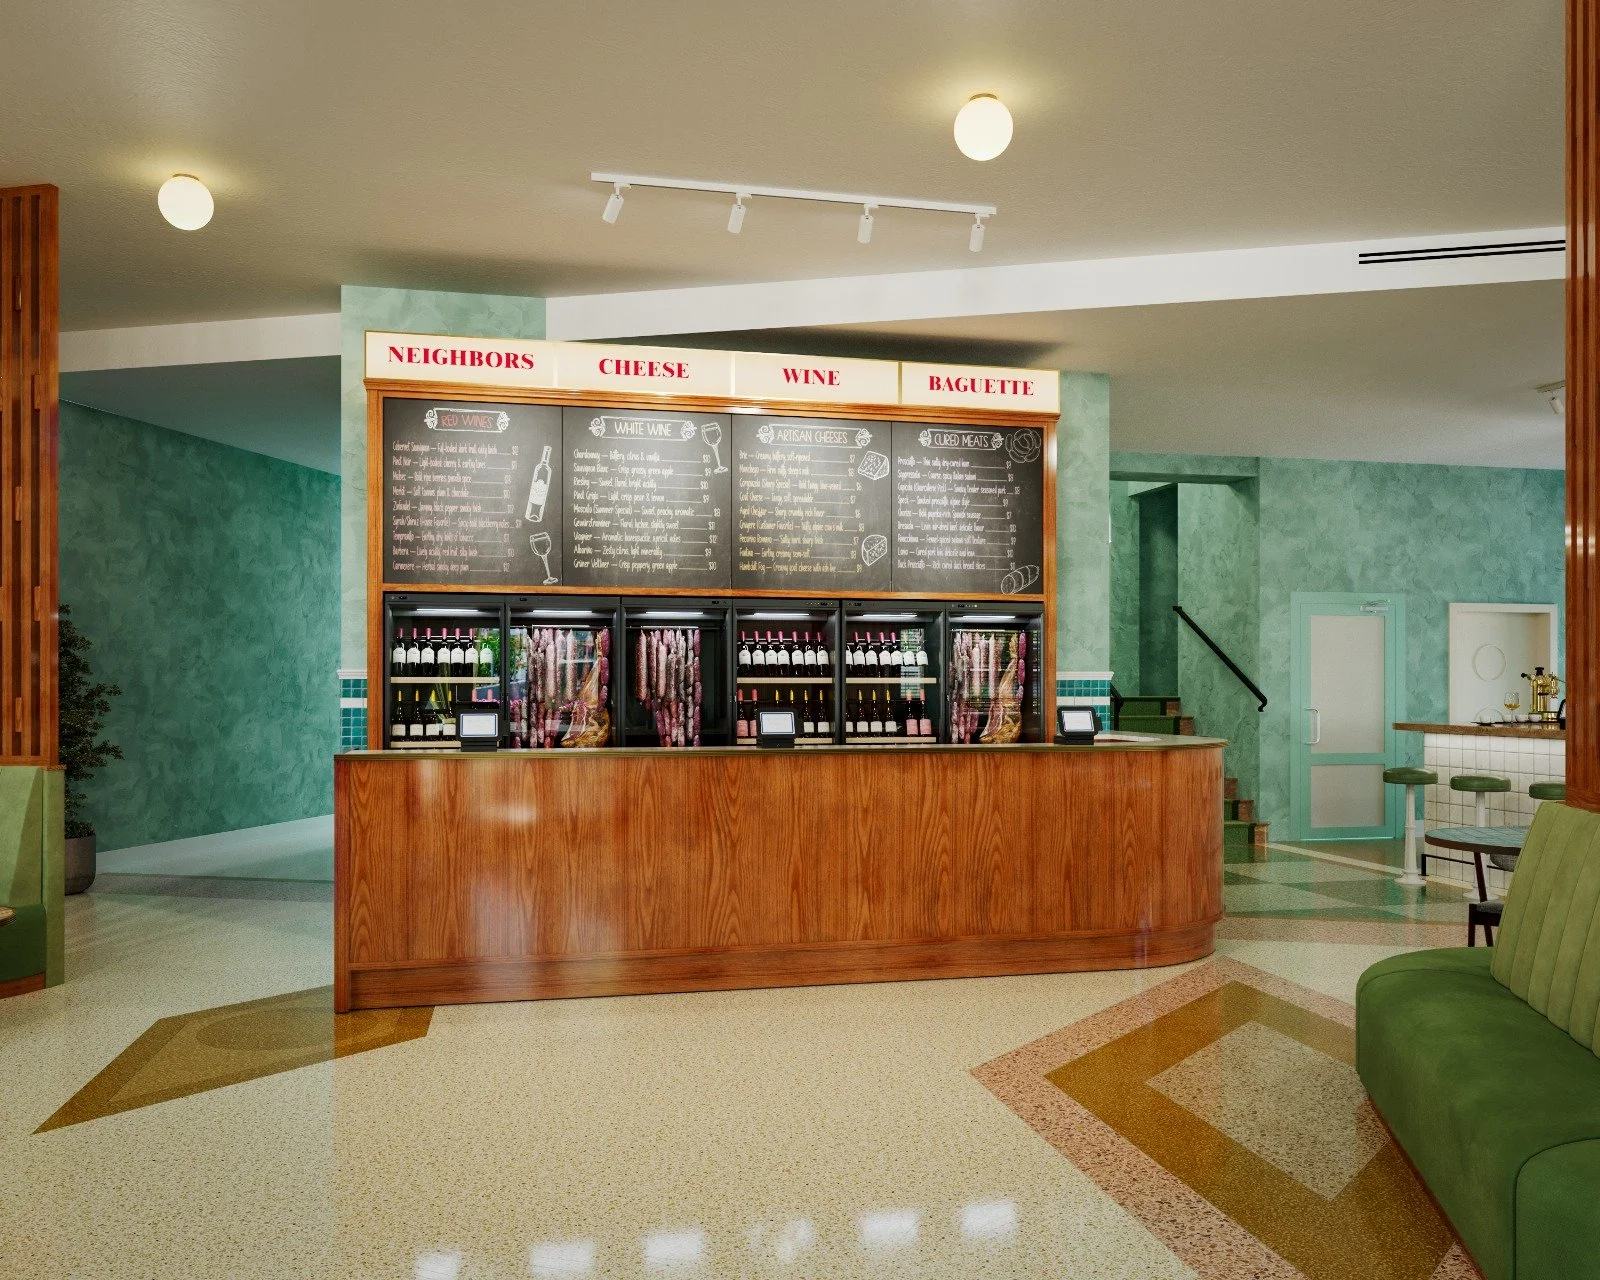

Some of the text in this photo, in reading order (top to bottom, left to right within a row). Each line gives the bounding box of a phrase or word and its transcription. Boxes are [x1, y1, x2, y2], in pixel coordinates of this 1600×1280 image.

[389, 346, 534, 370] NEIGHBORS
[598, 358, 689, 379] CHEESE
[783, 367, 840, 386] WINE
[928, 375, 1034, 396] BAGUETTE
[441, 415, 493, 428] RED WINES
[614, 422, 672, 437] WHITE WINE
[777, 429, 848, 444] ARTISAN CHEESES
[935, 433, 989, 448] CURED MEATS
[574, 449, 601, 463] Chardonnay
[574, 463, 596, 476] Sauvignon
[597, 463, 609, 473] Blanc
